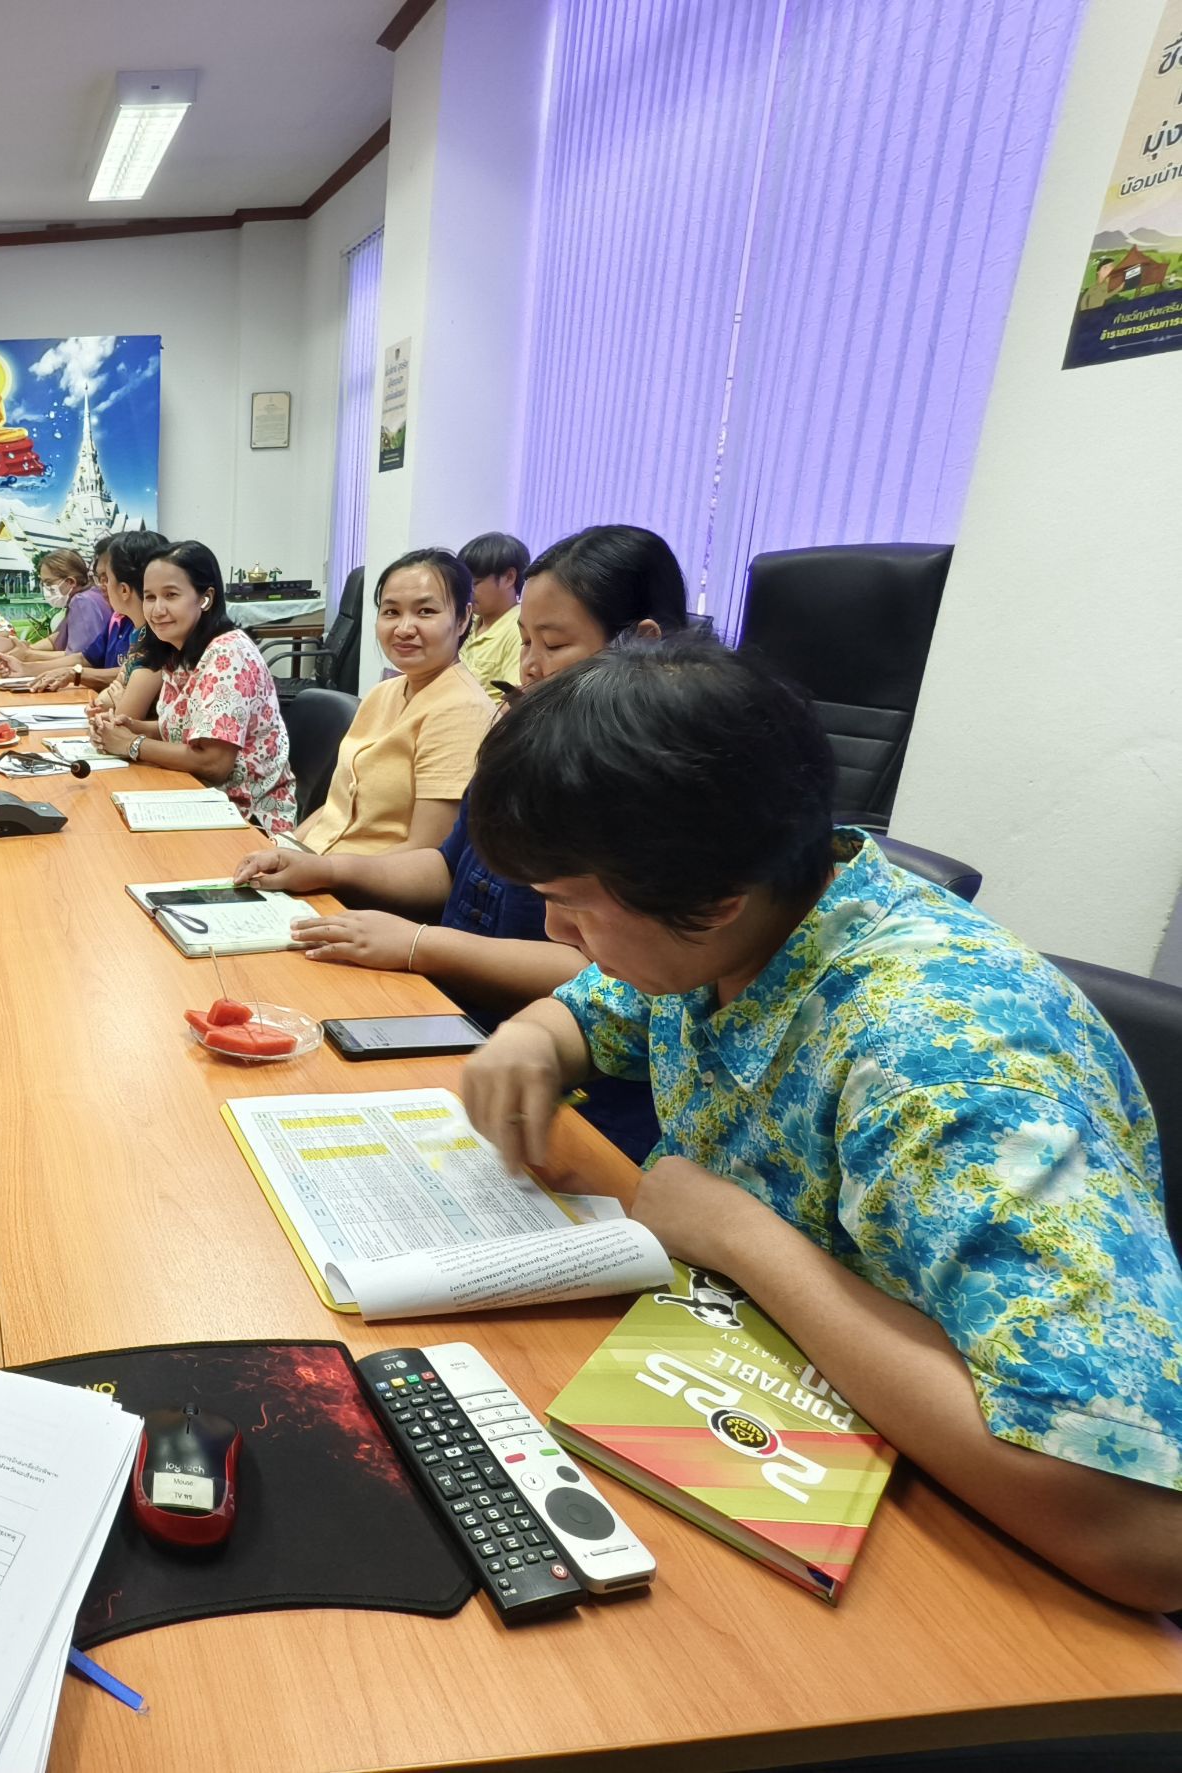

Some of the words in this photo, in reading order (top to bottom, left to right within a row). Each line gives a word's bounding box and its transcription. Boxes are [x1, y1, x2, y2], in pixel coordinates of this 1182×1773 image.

[720, 1331, 802, 1375] STRATEGY
[704, 1347, 854, 1432] PORTABLE
[173, 1477, 194, 1487] Mouse
[478, 1495, 491, 1505] 0
[488, 1509, 500, 1519] 8
[513, 1504, 523, 1514] 7
[465, 1515, 477, 1525] 9
[520, 1519, 530, 1528] 4
[497, 1523, 509, 1533] 5
[473, 1529, 486, 1540] 6
[532, 1533, 540, 1542] 1
[505, 1538, 519, 1549] 2
[482, 1544, 496, 1554] 3
